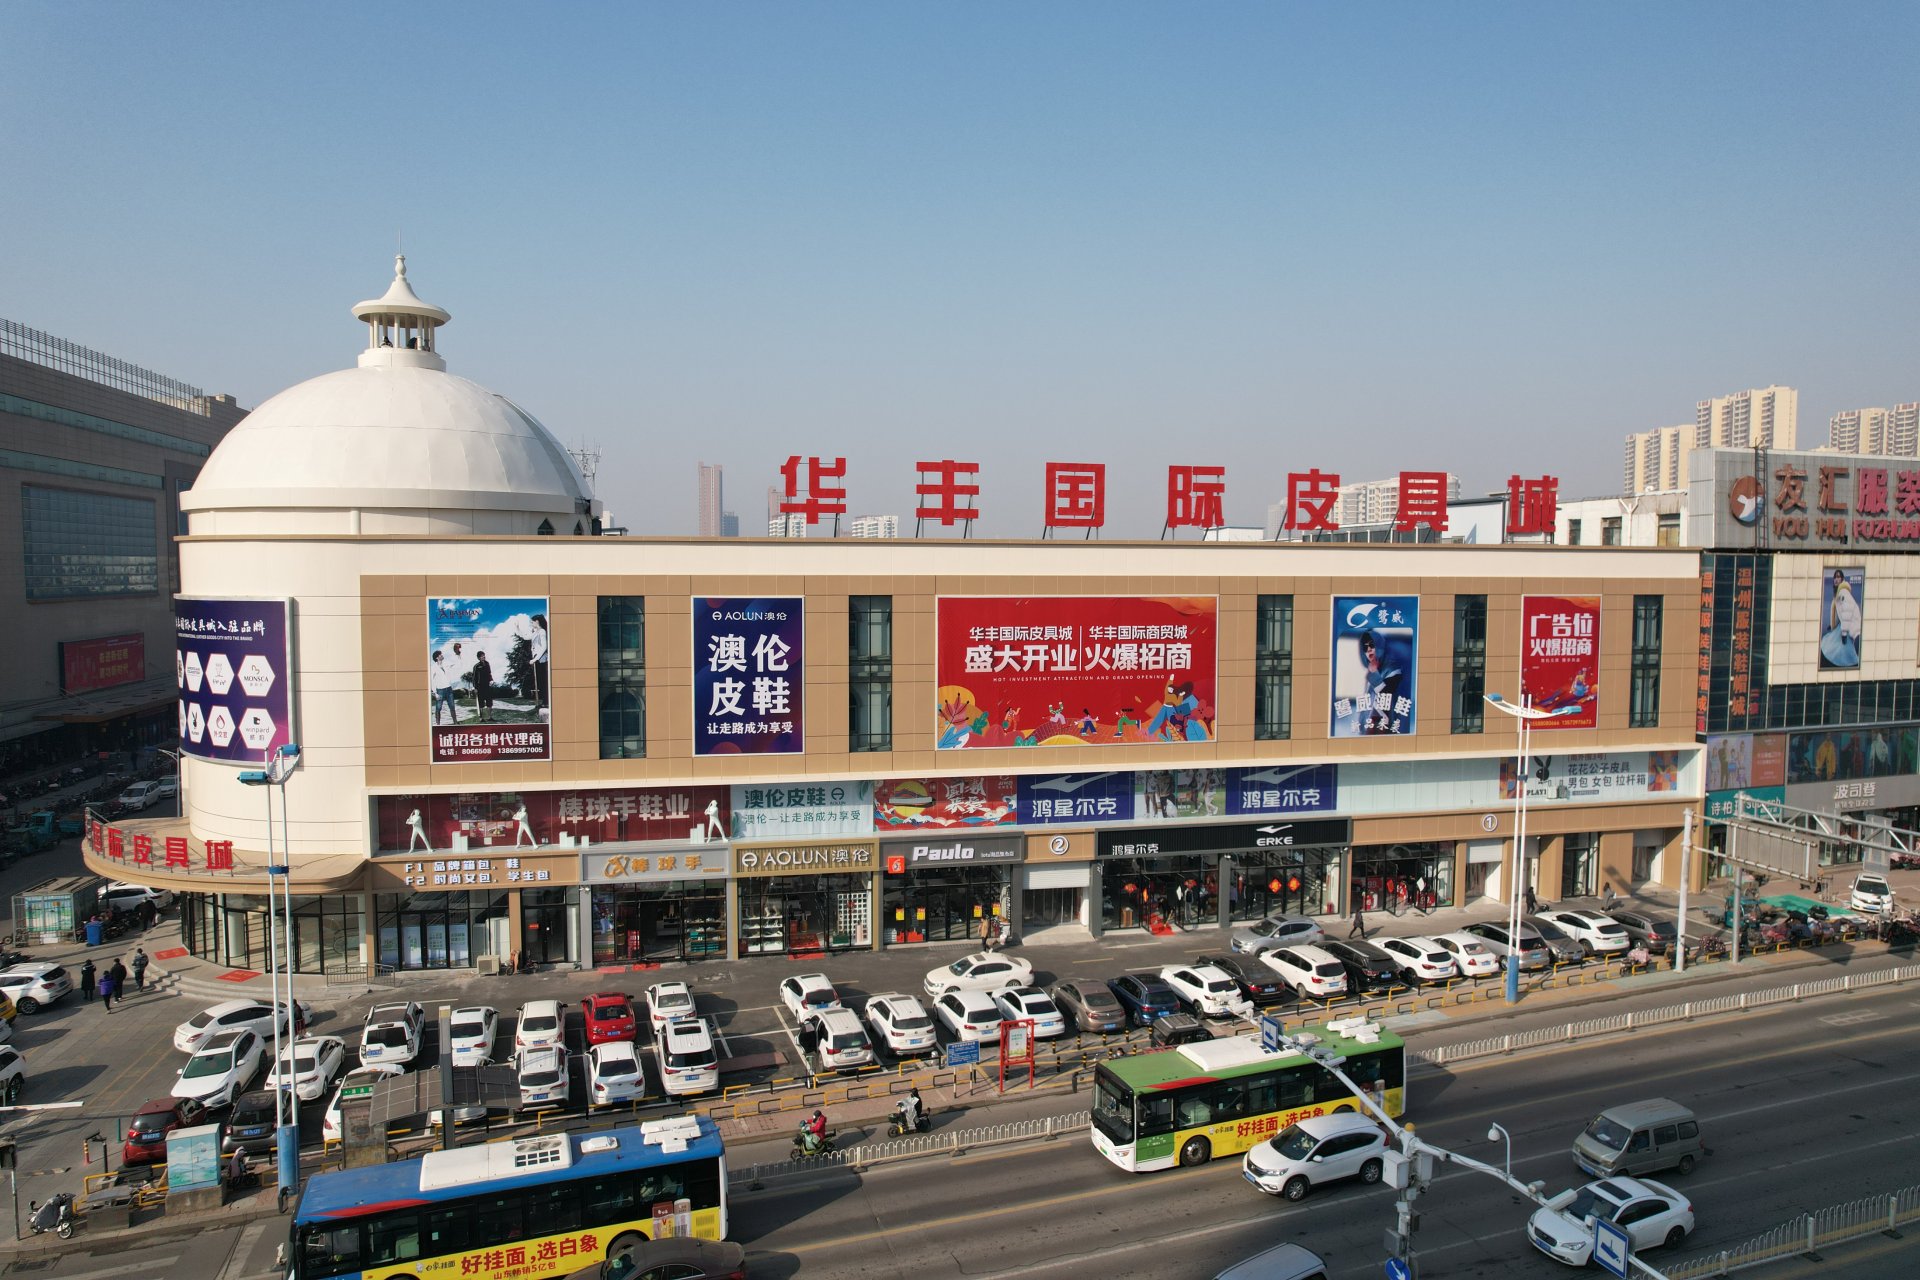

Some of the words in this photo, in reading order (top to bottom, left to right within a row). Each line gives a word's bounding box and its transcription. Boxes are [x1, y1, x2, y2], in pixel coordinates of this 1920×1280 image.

[780, 456, 1558, 532] 华丰国际皮具城
[1775, 463, 1920, 513] 友汇服装
[1773, 517, 1809, 537] YOU
[1817, 516, 1847, 538] HUI
[725, 612, 762, 620] AOLUN
[1530, 613, 1593, 637] 广告位
[970, 626, 1073, 642] 华丰国际皮具城
[1089, 624, 1188, 640] 华丰国际商贸城
[1731, 568, 1752, 716] 温州服装鞋帽城
[708, 634, 791, 672] 澳伦
[1530, 638, 1592, 656] 火爆招商
[965, 644, 1078, 673] 盛大开业
[1084, 642, 1192, 671] 火爆招商
[708, 677, 790, 716] 皮鞋
[707, 722, 794, 734] 让走路成为享受
[439, 732, 544, 748] 诚招各地代理商
[1568, 762, 1630, 776] 花花公子皮具
[1568, 777, 1588, 788] 男包
[1592, 776, 1612, 787] 女包
[1616, 774, 1646, 786] 拉杆箱
[744, 788, 826, 809] 澳伦皮鞋
[1242, 789, 1320, 808] 鸿星尔克
[1834, 782, 1876, 799] 波司登
[558, 794, 690, 824] 棒球手鞋业
[1032, 798, 1116, 818] 鸿星尔克
[92, 820, 234, 870] 国际皮具城
[1112, 843, 1159, 856] 鸿星尔克
[1256, 836, 1294, 846] ERKE
[764, 850, 828, 866] AOLUN
[832, 848, 870, 863] 澳伦
[913, 844, 974, 862] Paulo
[631, 855, 702, 872] 棒球手
